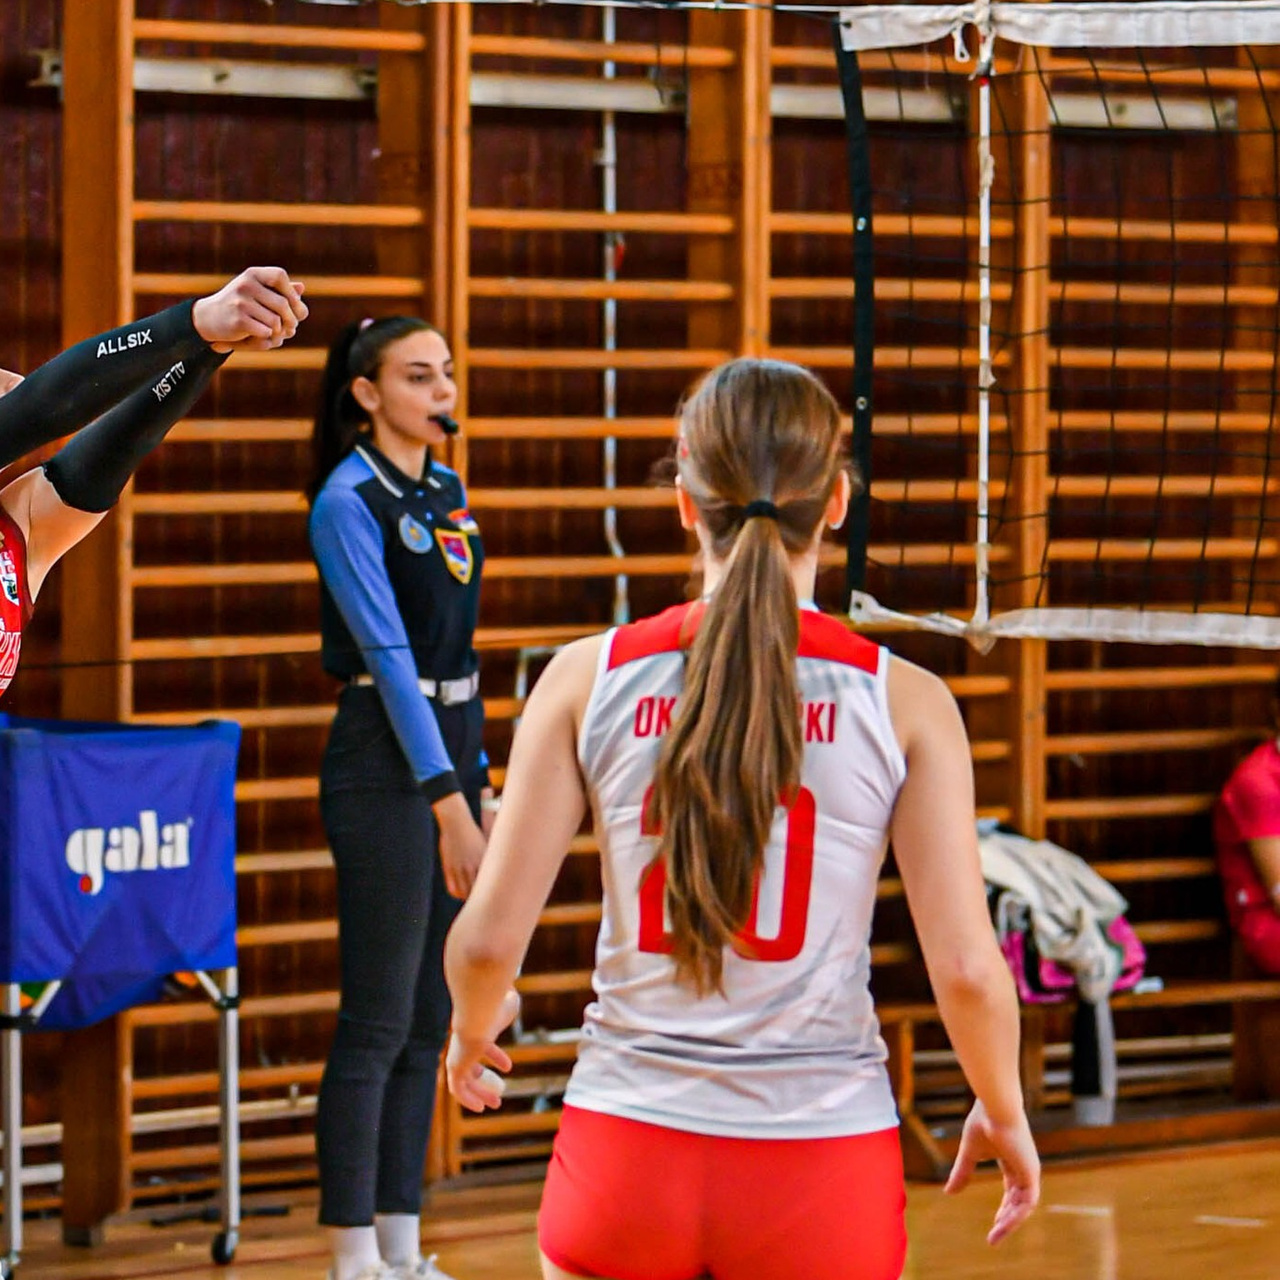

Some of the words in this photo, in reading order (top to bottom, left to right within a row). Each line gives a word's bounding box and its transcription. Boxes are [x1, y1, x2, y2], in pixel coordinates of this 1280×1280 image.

[96, 329, 153, 358] ALLSIX
[152, 361, 186, 402] ALLSIX
[65, 809, 190, 896] gala
